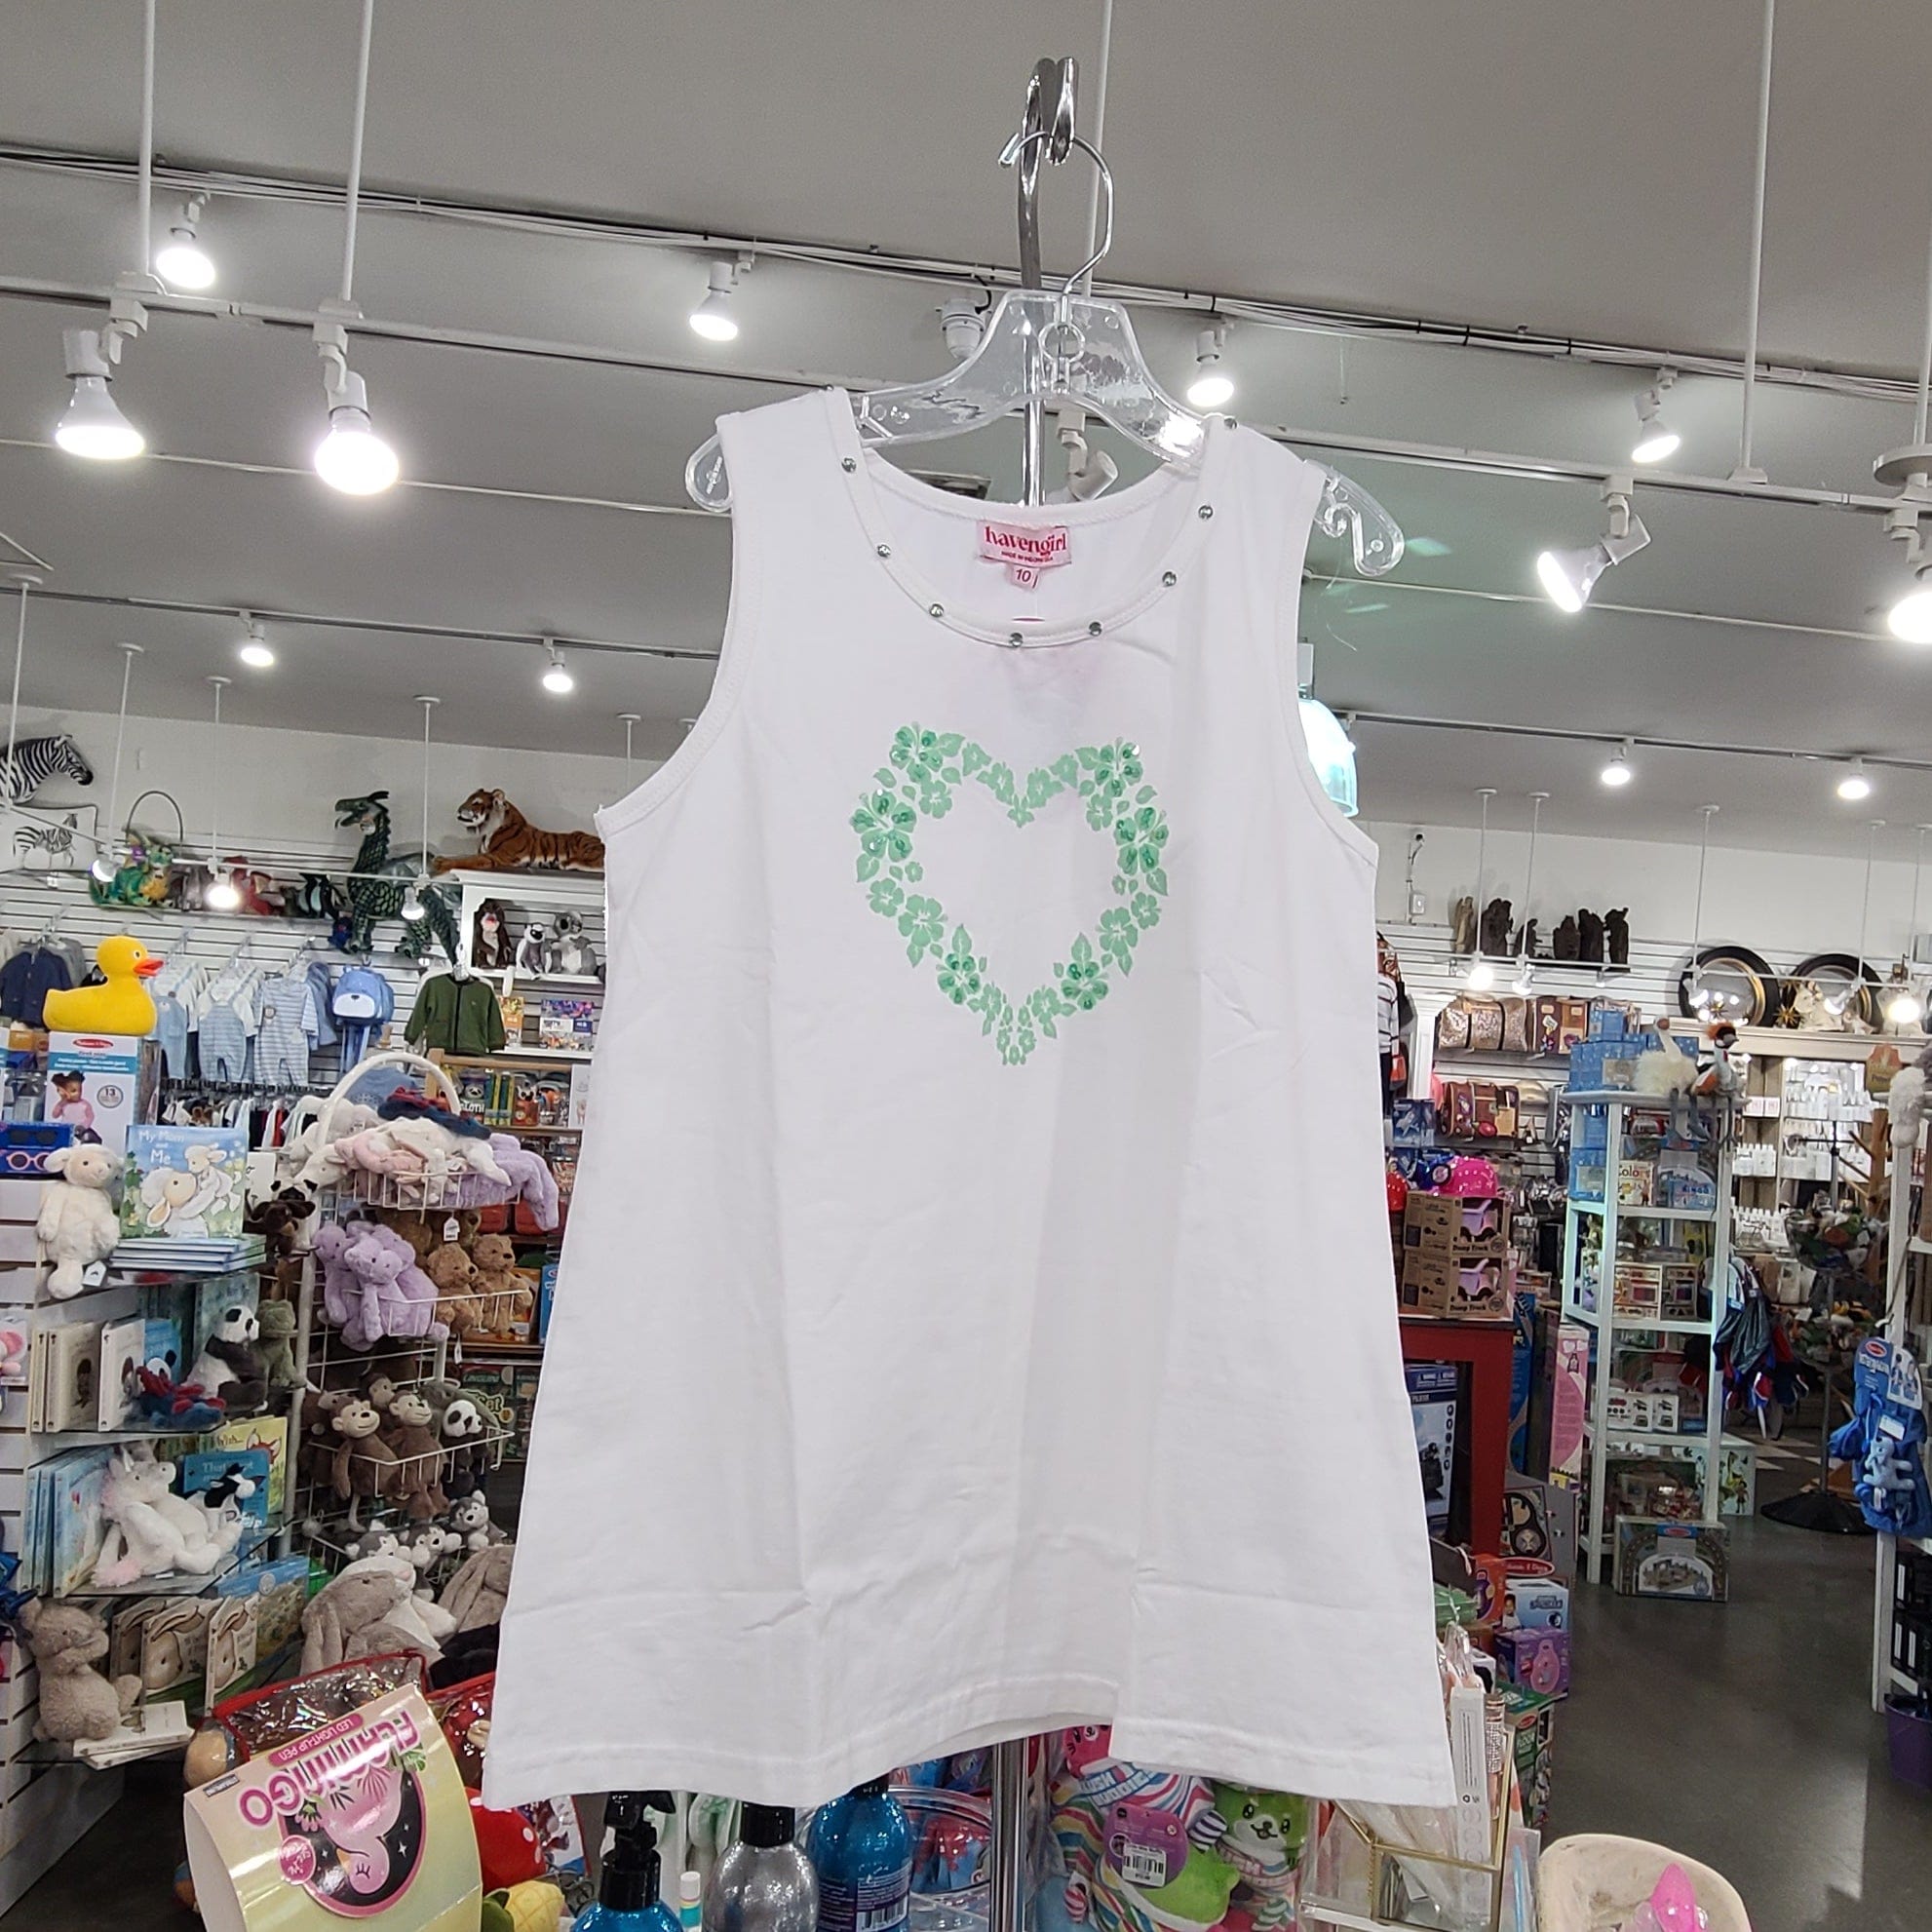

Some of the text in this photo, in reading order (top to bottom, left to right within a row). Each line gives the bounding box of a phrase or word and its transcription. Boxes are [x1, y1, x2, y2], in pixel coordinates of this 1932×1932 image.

[985, 526, 1066, 556] havengirl
[1016, 568, 1031, 582] 10
[138, 1130, 156, 1142] My
[150, 1149, 172, 1165] Me
